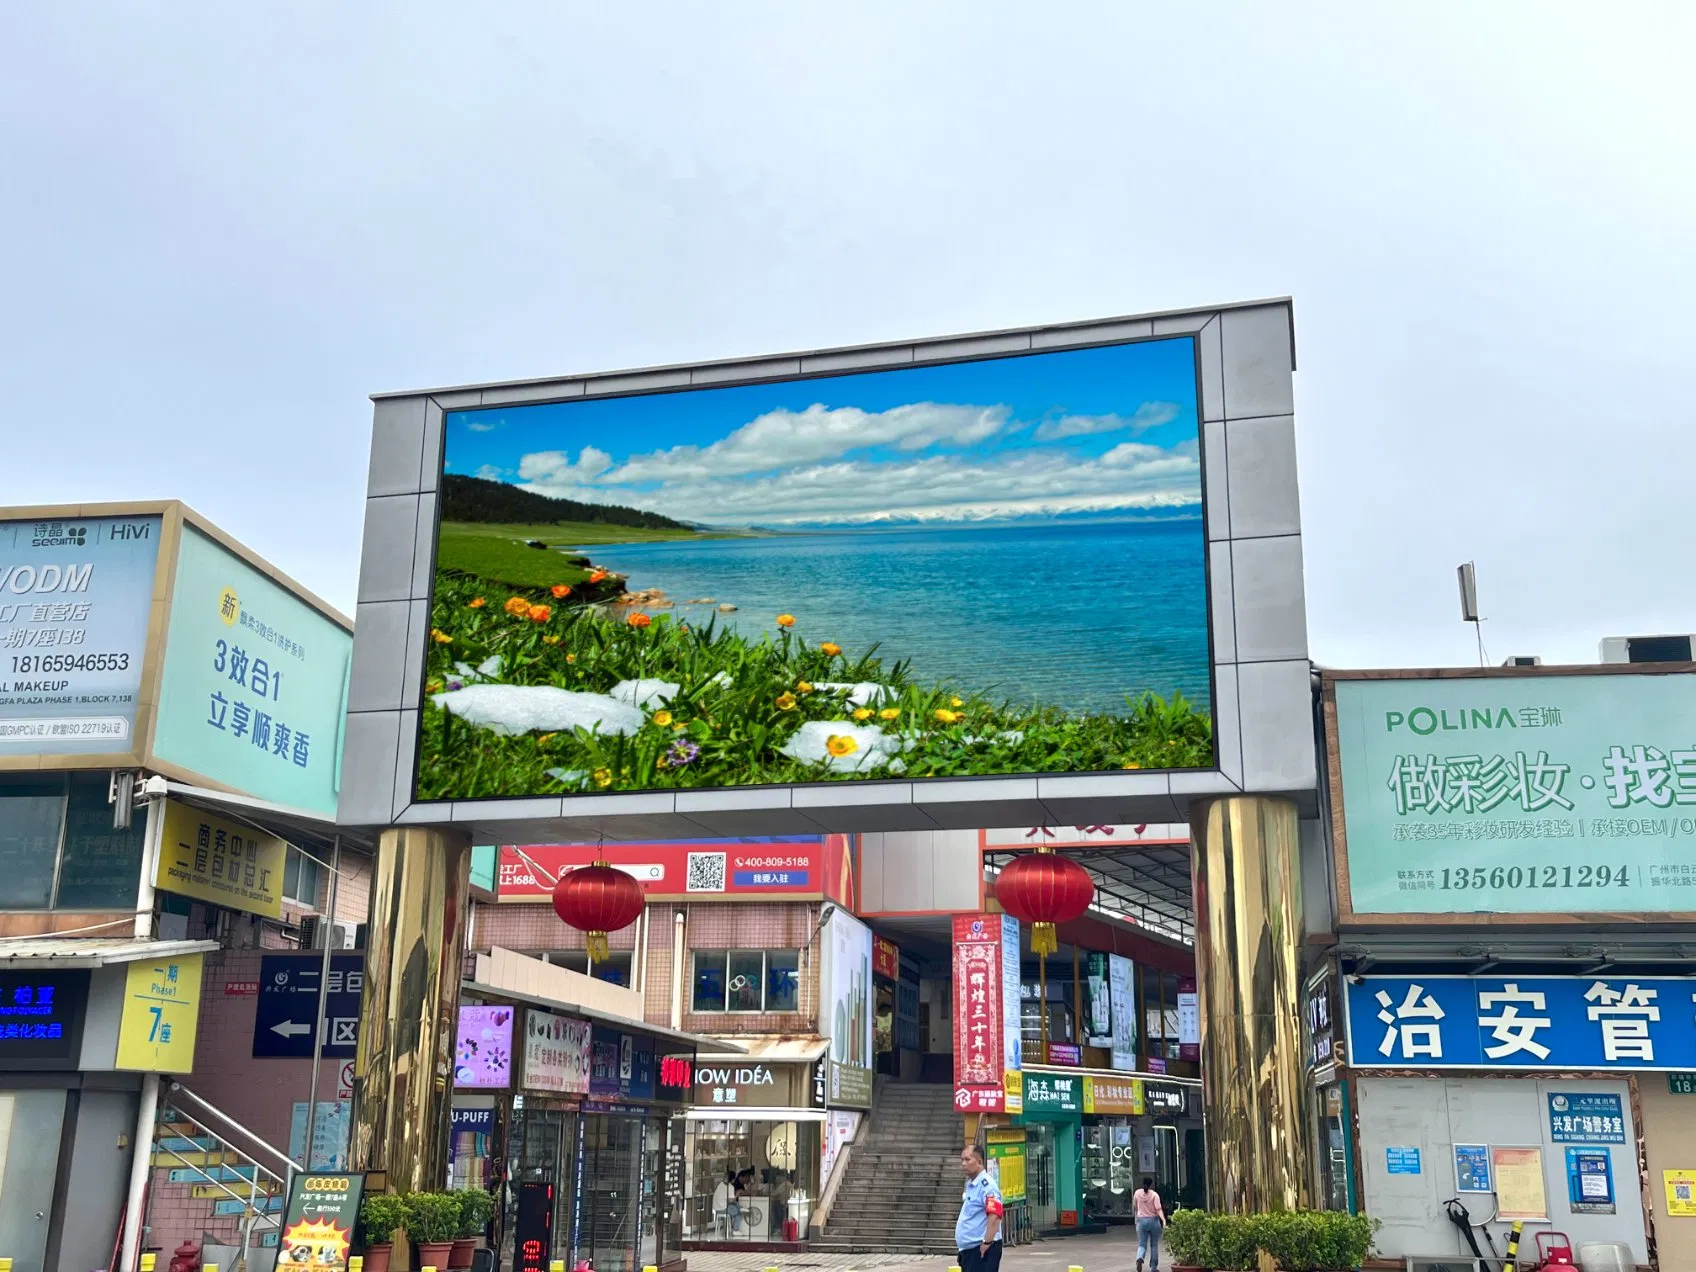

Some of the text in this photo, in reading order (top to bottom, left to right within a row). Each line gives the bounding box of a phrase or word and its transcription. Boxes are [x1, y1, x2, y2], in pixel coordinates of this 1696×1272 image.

[110, 523, 150, 540] HiVi
[0, 601, 92, 623] 工厂直营店
[222, 593, 236, 619] 新
[12, 653, 129, 673] 18165946553
[214, 639, 281, 701] 3效合1
[14, 680, 69, 692] MAKEUP
[45, 696, 72, 704] PHASE
[207, 690, 310, 768] 立享顺爽香
[1386, 706, 1564, 736] POLINA 宝琳
[199, 823, 257, 864] 商务中心
[745, 857, 809, 867] 400-809-5188
[753, 873, 788, 884] 我要入驻
[1397, 870, 1434, 879] 联系方式
[1440, 865, 1630, 889] 13560121294
[1398, 881, 1435, 890] 微信同号
[154, 965, 179, 983] 一期
[970, 972, 987, 1052] 辉煌三十年
[1375, 981, 1696, 1061] 治安管
[148, 1006, 172, 1044] 7座
[735, 1065, 774, 1085] IDÉA
[451, 1111, 490, 1122] U-PUFF
[1553, 1115, 1623, 1133] 兴发广场警务室
